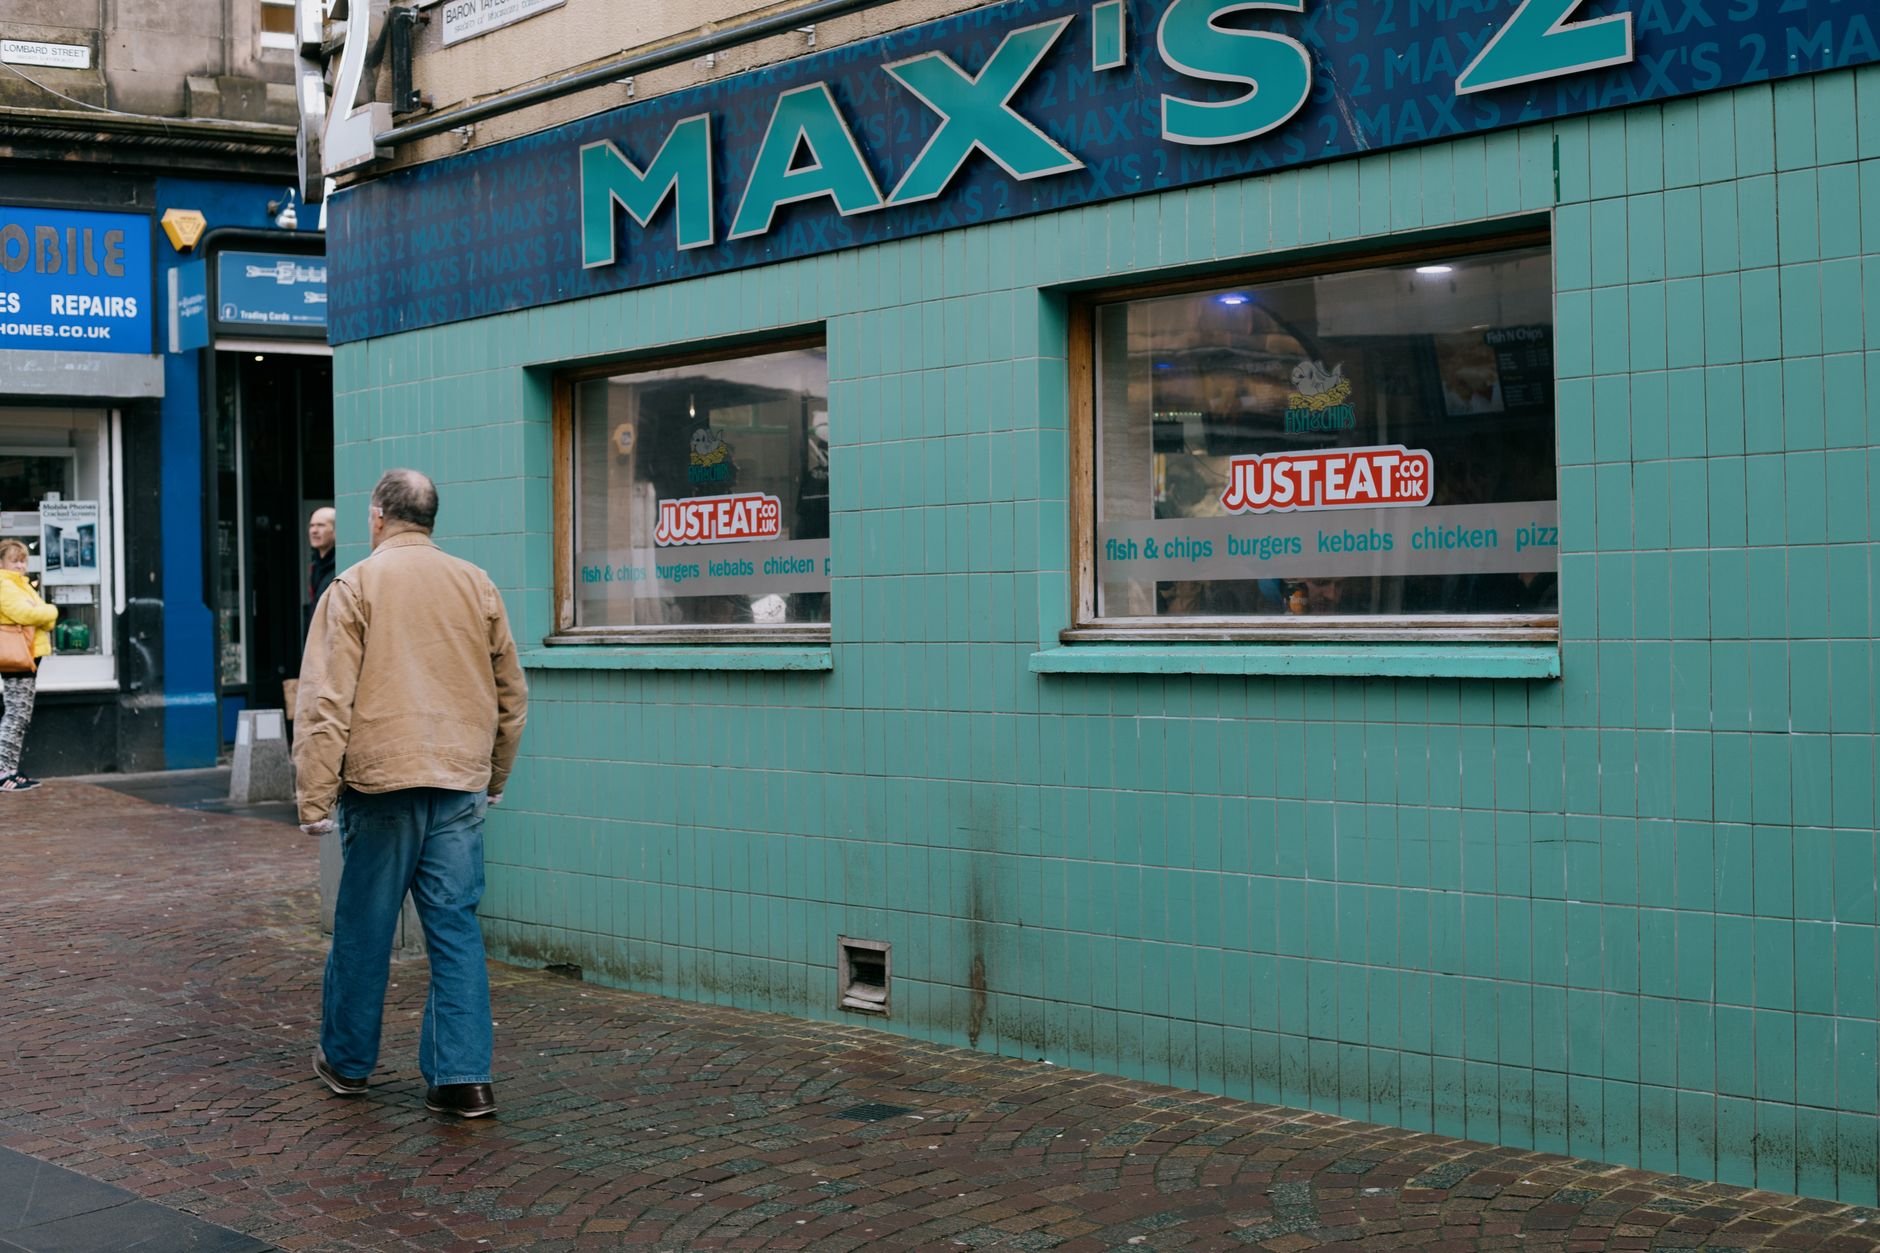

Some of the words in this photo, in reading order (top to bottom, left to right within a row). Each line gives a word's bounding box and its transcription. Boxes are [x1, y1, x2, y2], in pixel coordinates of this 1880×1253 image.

[446, 3, 476, 24] BARON
[3, 44, 48, 55] LOMBARD
[51, 47, 87, 58] STREET
[1556, 41, 1723, 117] MAX'S
[1738, 33, 1770, 82] 2
[579, 0, 1312, 270] MAX'S
[401, 255, 461, 296] MAX'S
[481, 234, 547, 277] MAX'S
[1349, 53, 1372, 97] 2
[411, 211, 472, 257] MAX'S
[492, 194, 559, 238] MAX'S
[51, 294, 137, 318] REPAIRS
[69, 503, 96, 511] Phones
[1105, 537, 1138, 561] fish
[1143, 538, 1159, 559] &
[1164, 534, 1213, 563] chips
[1227, 533, 1302, 561] burgers
[1318, 527, 1393, 553] kebabs
[1411, 523, 1498, 550] chicken
[581, 565, 601, 584] fish
[604, 564, 614, 582] &
[617, 562, 647, 583] chips
[655, 561, 700, 583] burgers
[709, 558, 754, 577] kebabs
[763, 555, 814, 575] chicken
